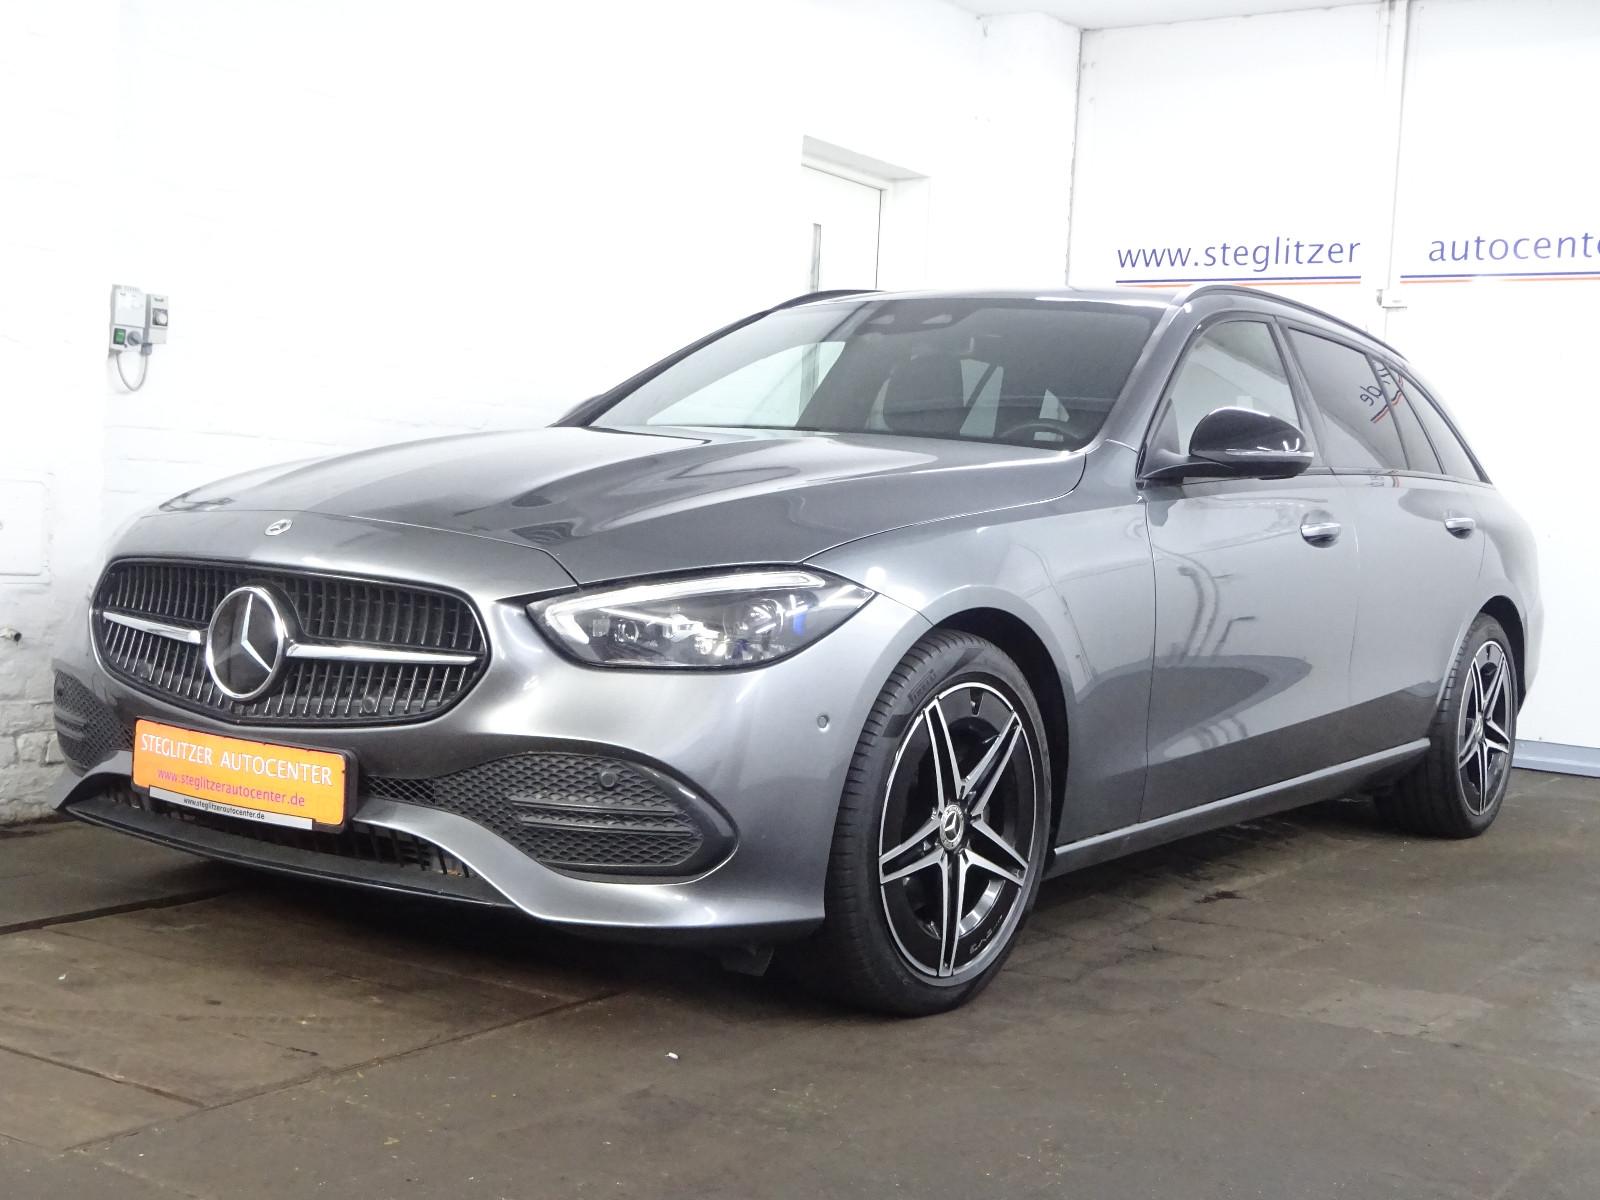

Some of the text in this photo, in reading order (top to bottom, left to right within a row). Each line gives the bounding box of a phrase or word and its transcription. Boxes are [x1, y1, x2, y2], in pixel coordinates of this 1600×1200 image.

[1117, 232, 1600, 272] www.steglitzer autocent
[141, 733, 333, 786] STEGLITZER AUTOCENTER
[157, 769, 305, 807] www.steglitzerautocenter.de
[183, 797, 265, 820] www.steglitzerautocenter.de
